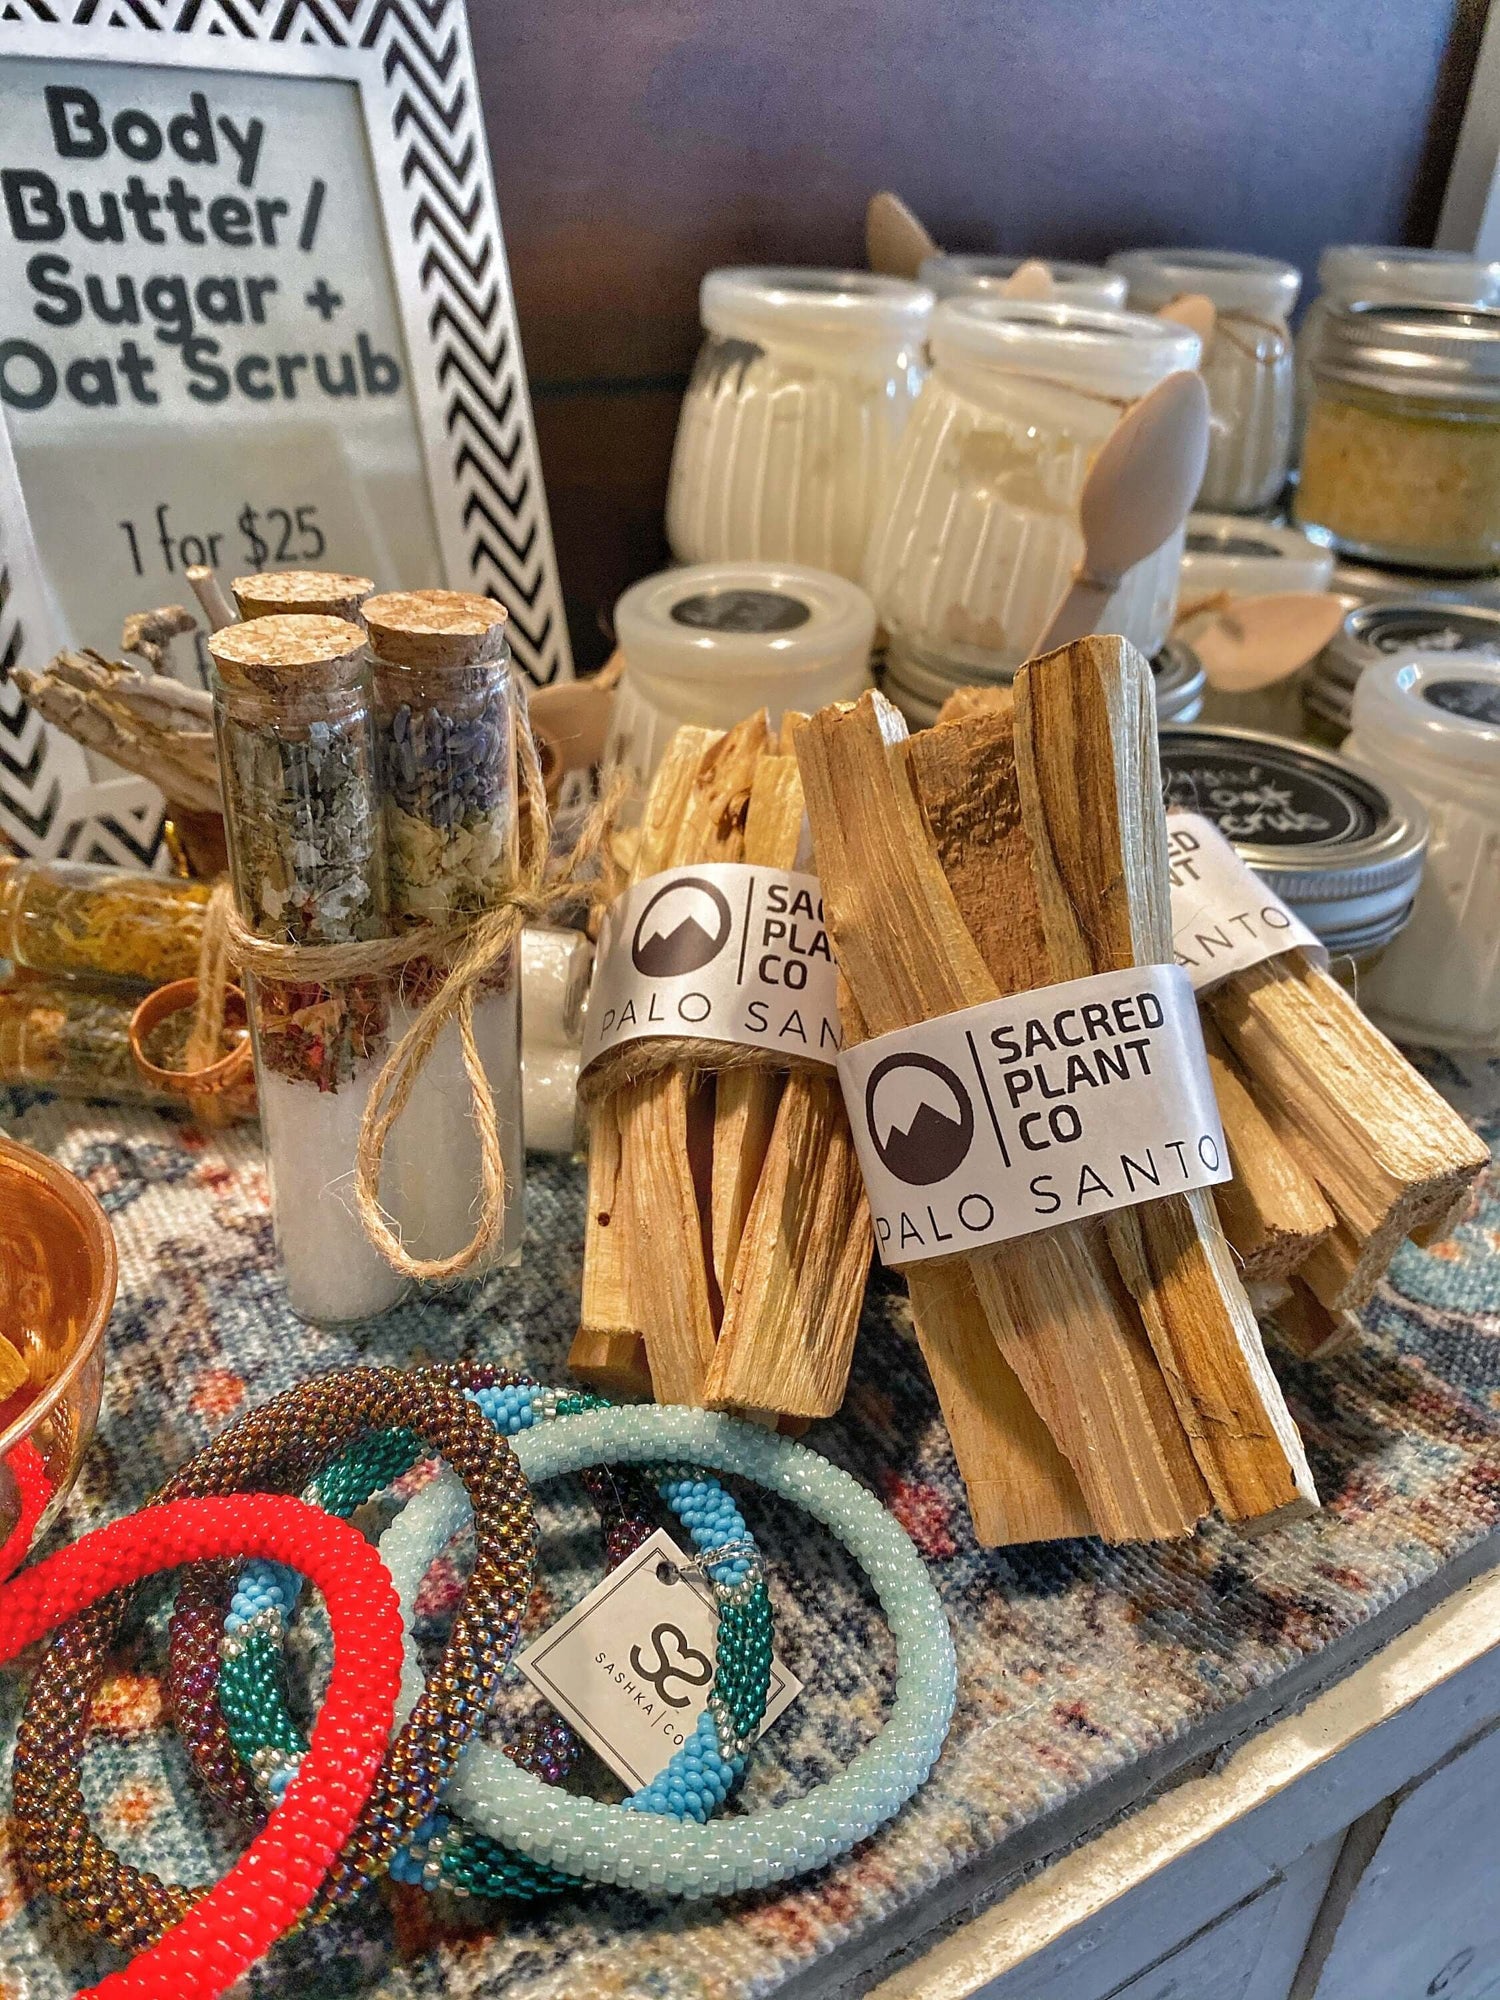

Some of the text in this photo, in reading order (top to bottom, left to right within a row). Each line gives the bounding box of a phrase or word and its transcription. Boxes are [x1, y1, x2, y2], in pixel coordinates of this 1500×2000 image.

[45, 85, 263, 186] Body
[1, 168, 326, 250] Butter/
[27, 253, 343, 346] Sugar +
[0, 332, 402, 410] Oat Scrub
[120, 504, 327, 577] 1 for $25
[758, 954, 808, 990] CO
[762, 918, 837, 965] PLA
[1173, 906, 1290, 966] ANTO
[600, 992, 843, 1051] PALO SAN
[989, 992, 1164, 1065] SACRED
[1004, 1038, 1152, 1109] PLANT
[1018, 1104, 1083, 1151] CO
[876, 1134, 1219, 1253] PALO SANTO
